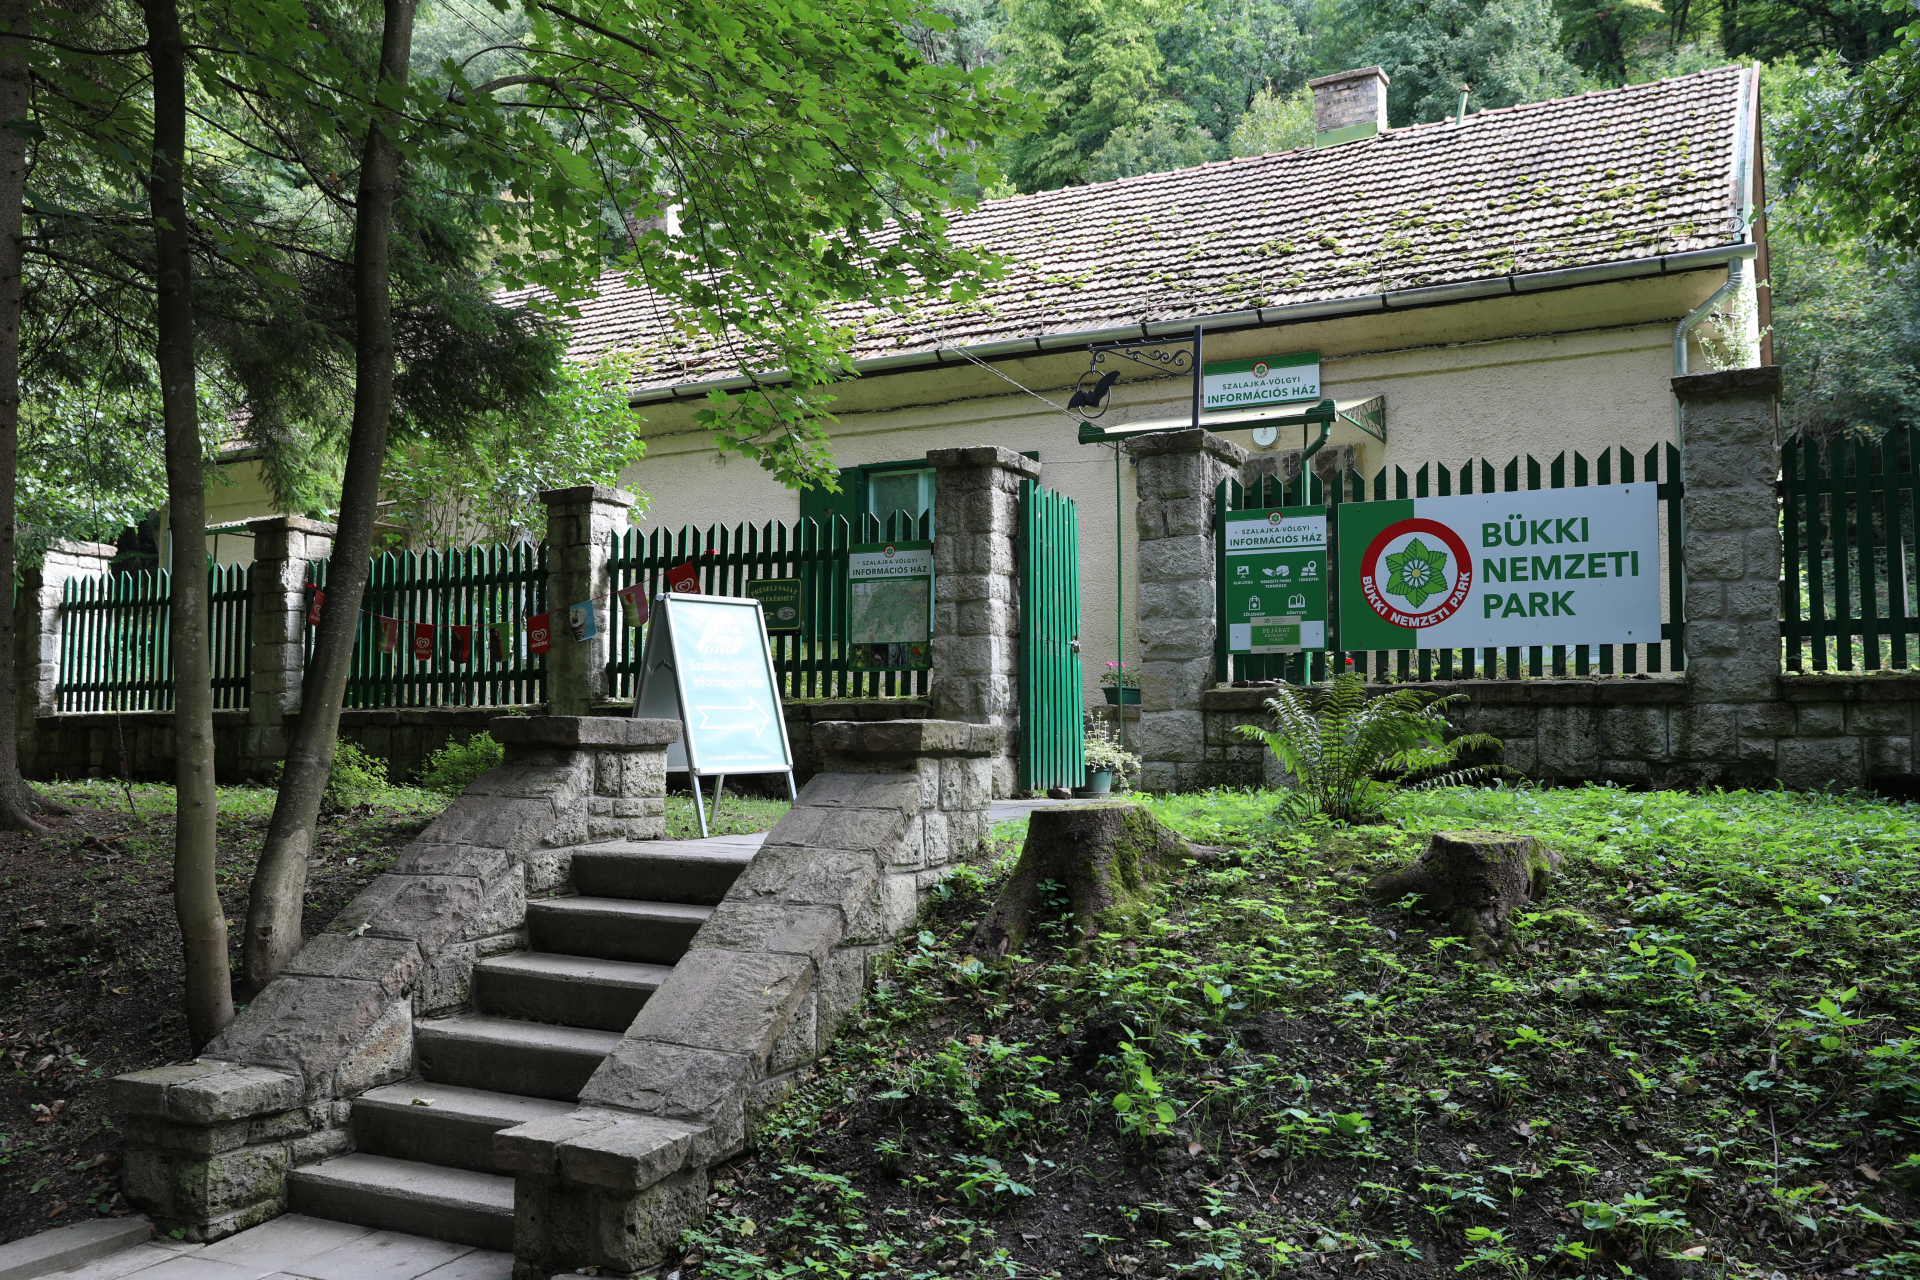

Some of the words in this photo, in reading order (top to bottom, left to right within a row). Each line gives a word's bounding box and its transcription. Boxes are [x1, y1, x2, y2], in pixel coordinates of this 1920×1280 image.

[1222, 376, 1301, 390] SZALAJKA-VÖLGYI
[1207, 387, 1288, 404] INFORMÁCIÓS
[1292, 385, 1316, 396] HÁZ
[1241, 525, 1310, 535] SZALAJKA-VÖLGYI
[1481, 513, 1589, 548] BÜKKI
[1230, 535, 1299, 547] INFORMÁCIÓS
[1301, 532, 1322, 542] HÁZ
[862, 558, 918, 566] SZALAJKA-VÖLGYI
[1482, 550, 1639, 584] NEMZETI
[852, 567, 908, 576] INFORMÁCIÓS
[910, 564, 928, 573] HÁZ
[1362, 576, 1388, 615] BÜKKI
[1390, 607, 1450, 627] NEMZETI
[1449, 571, 1471, 608] PARK
[1483, 590, 1576, 619] PARK
[1262, 626, 1291, 634] BEJÁRAT
[692, 675, 746, 688] információs
[746, 677, 764, 688] ház
